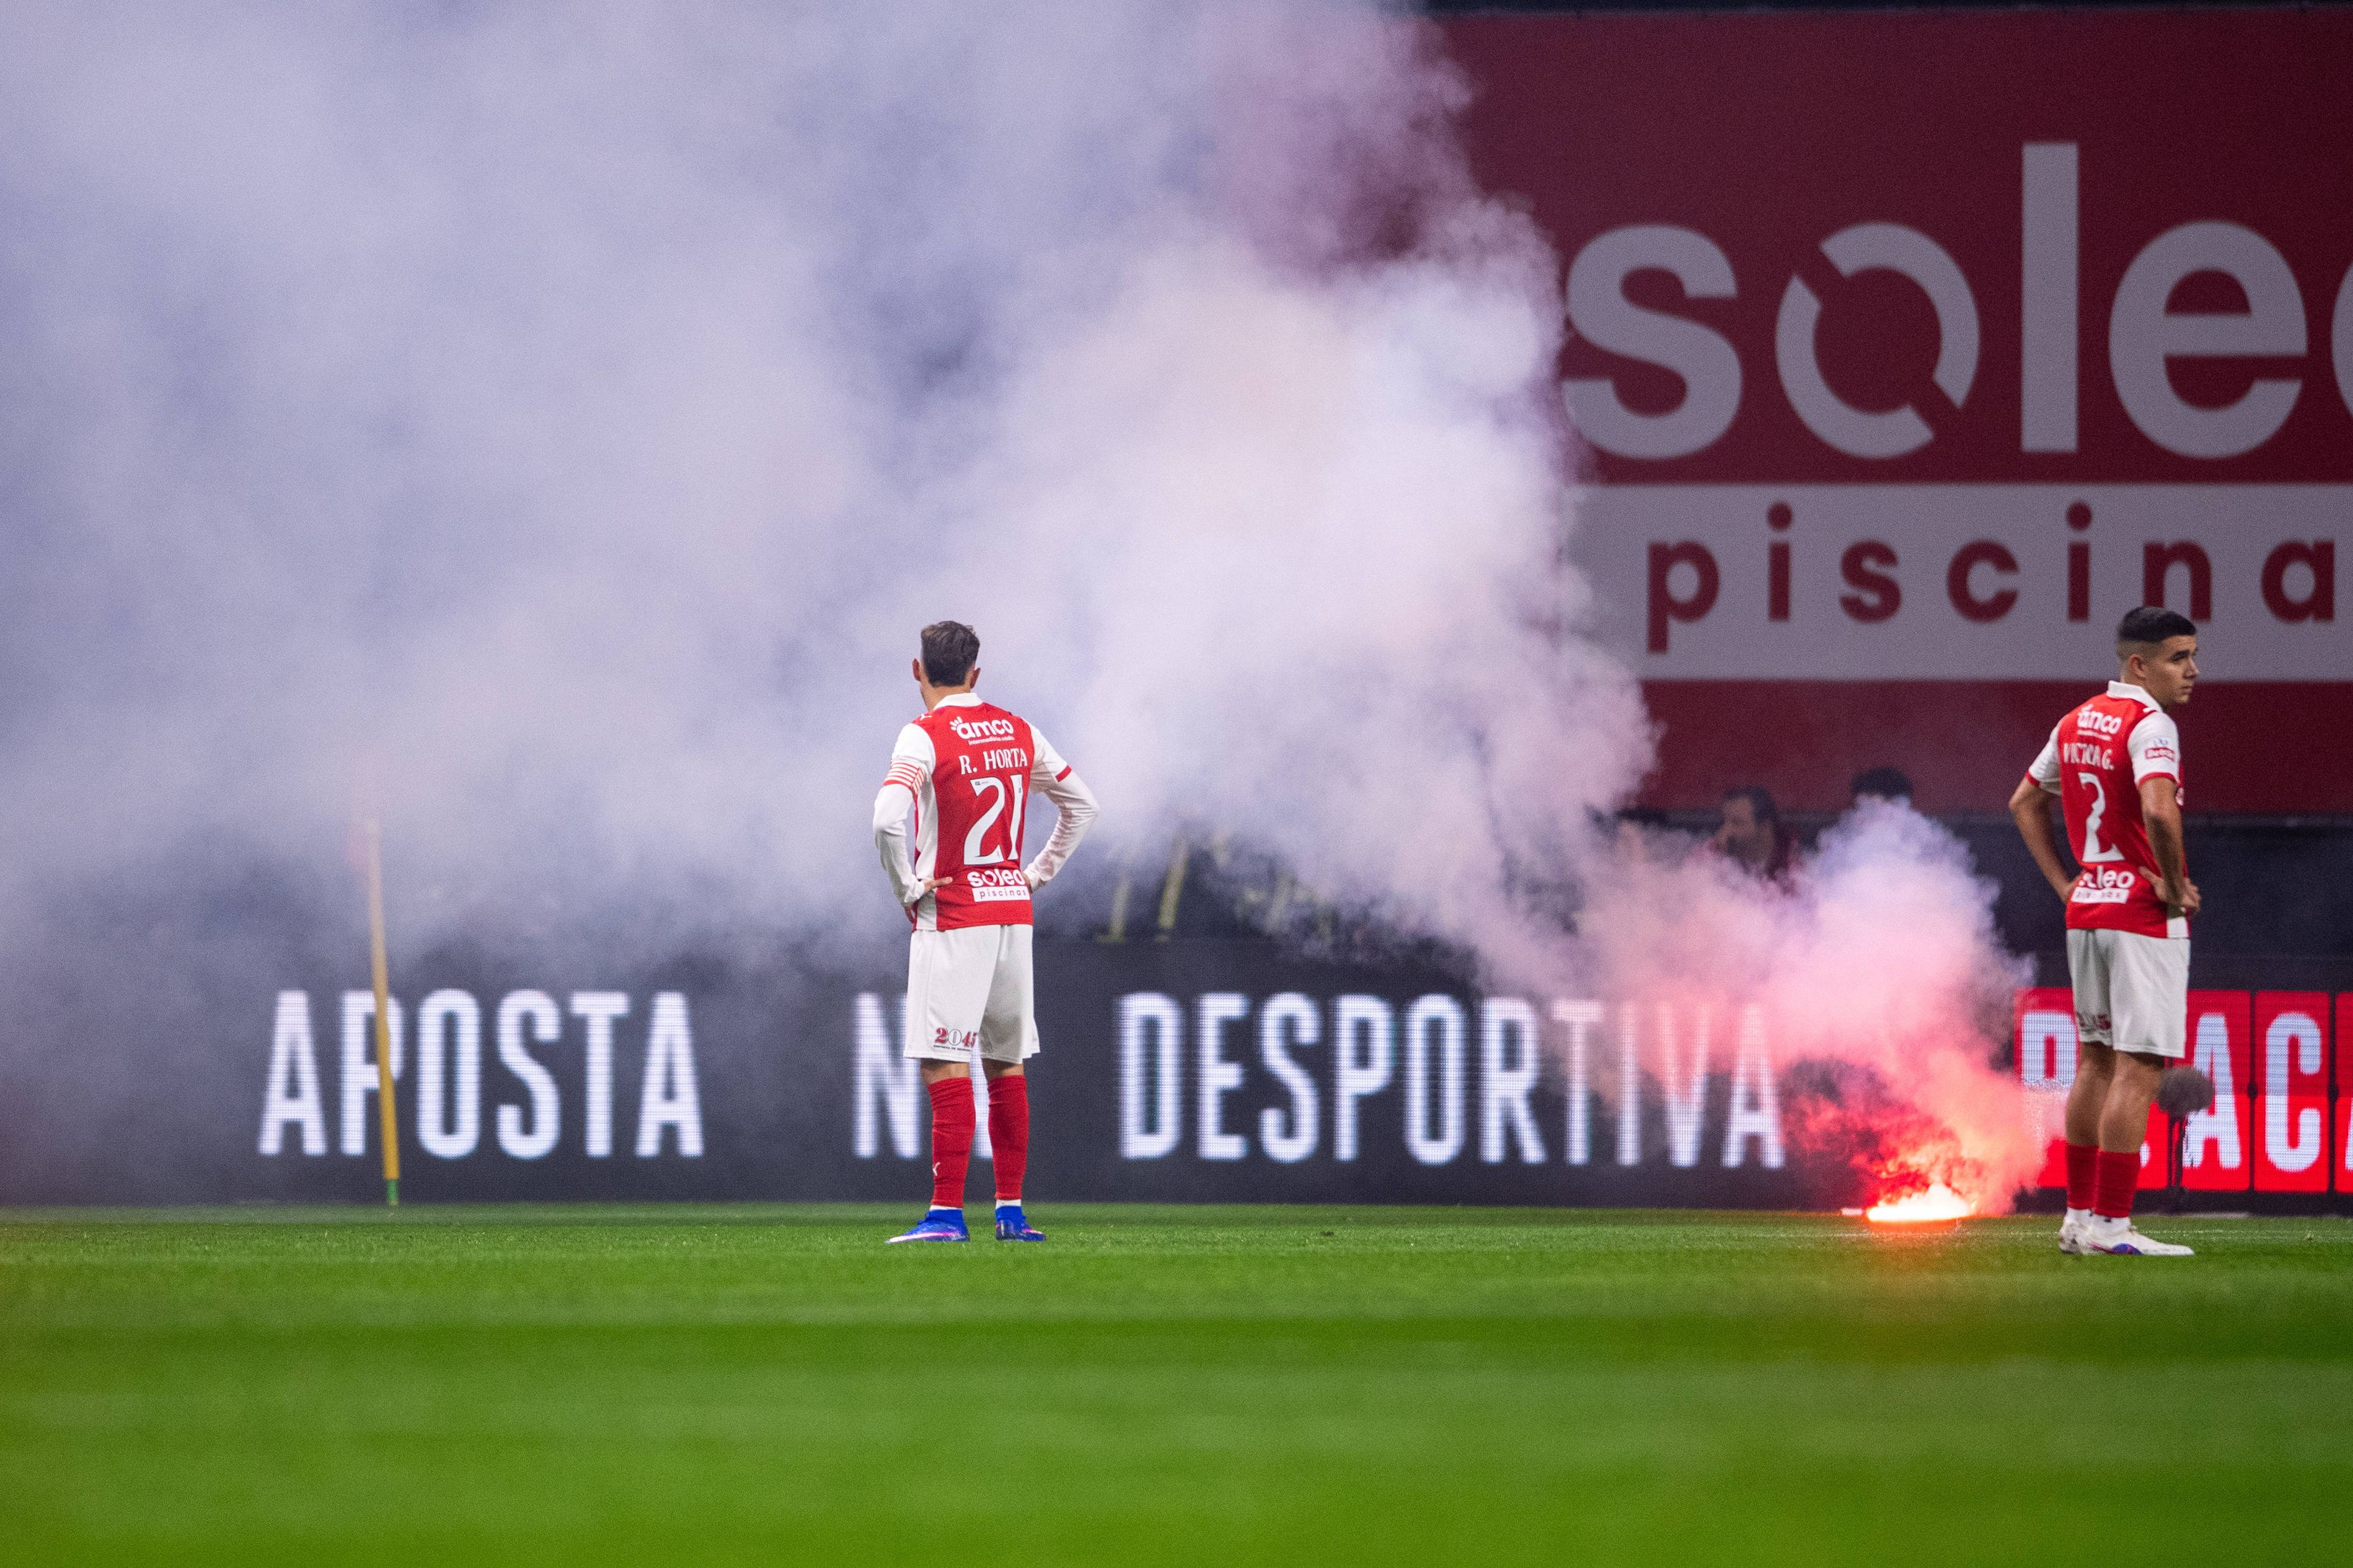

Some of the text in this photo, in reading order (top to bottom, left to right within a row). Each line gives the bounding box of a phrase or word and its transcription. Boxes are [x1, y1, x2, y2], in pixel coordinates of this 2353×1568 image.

[1562, 142, 2353, 459] sole
[1647, 501, 2335, 654] piscina
[955, 719, 1014, 739] amco
[958, 747, 1028, 775] R. HORTA
[963, 774, 1023, 865] 21
[2078, 772, 2126, 863] 2
[967, 868, 1026, 888] soleo
[979, 887, 1026, 898] piscinas
[258, 989, 704, 1159] APOSTA
[1119, 992, 1785, 1168] DESPORTIVA
